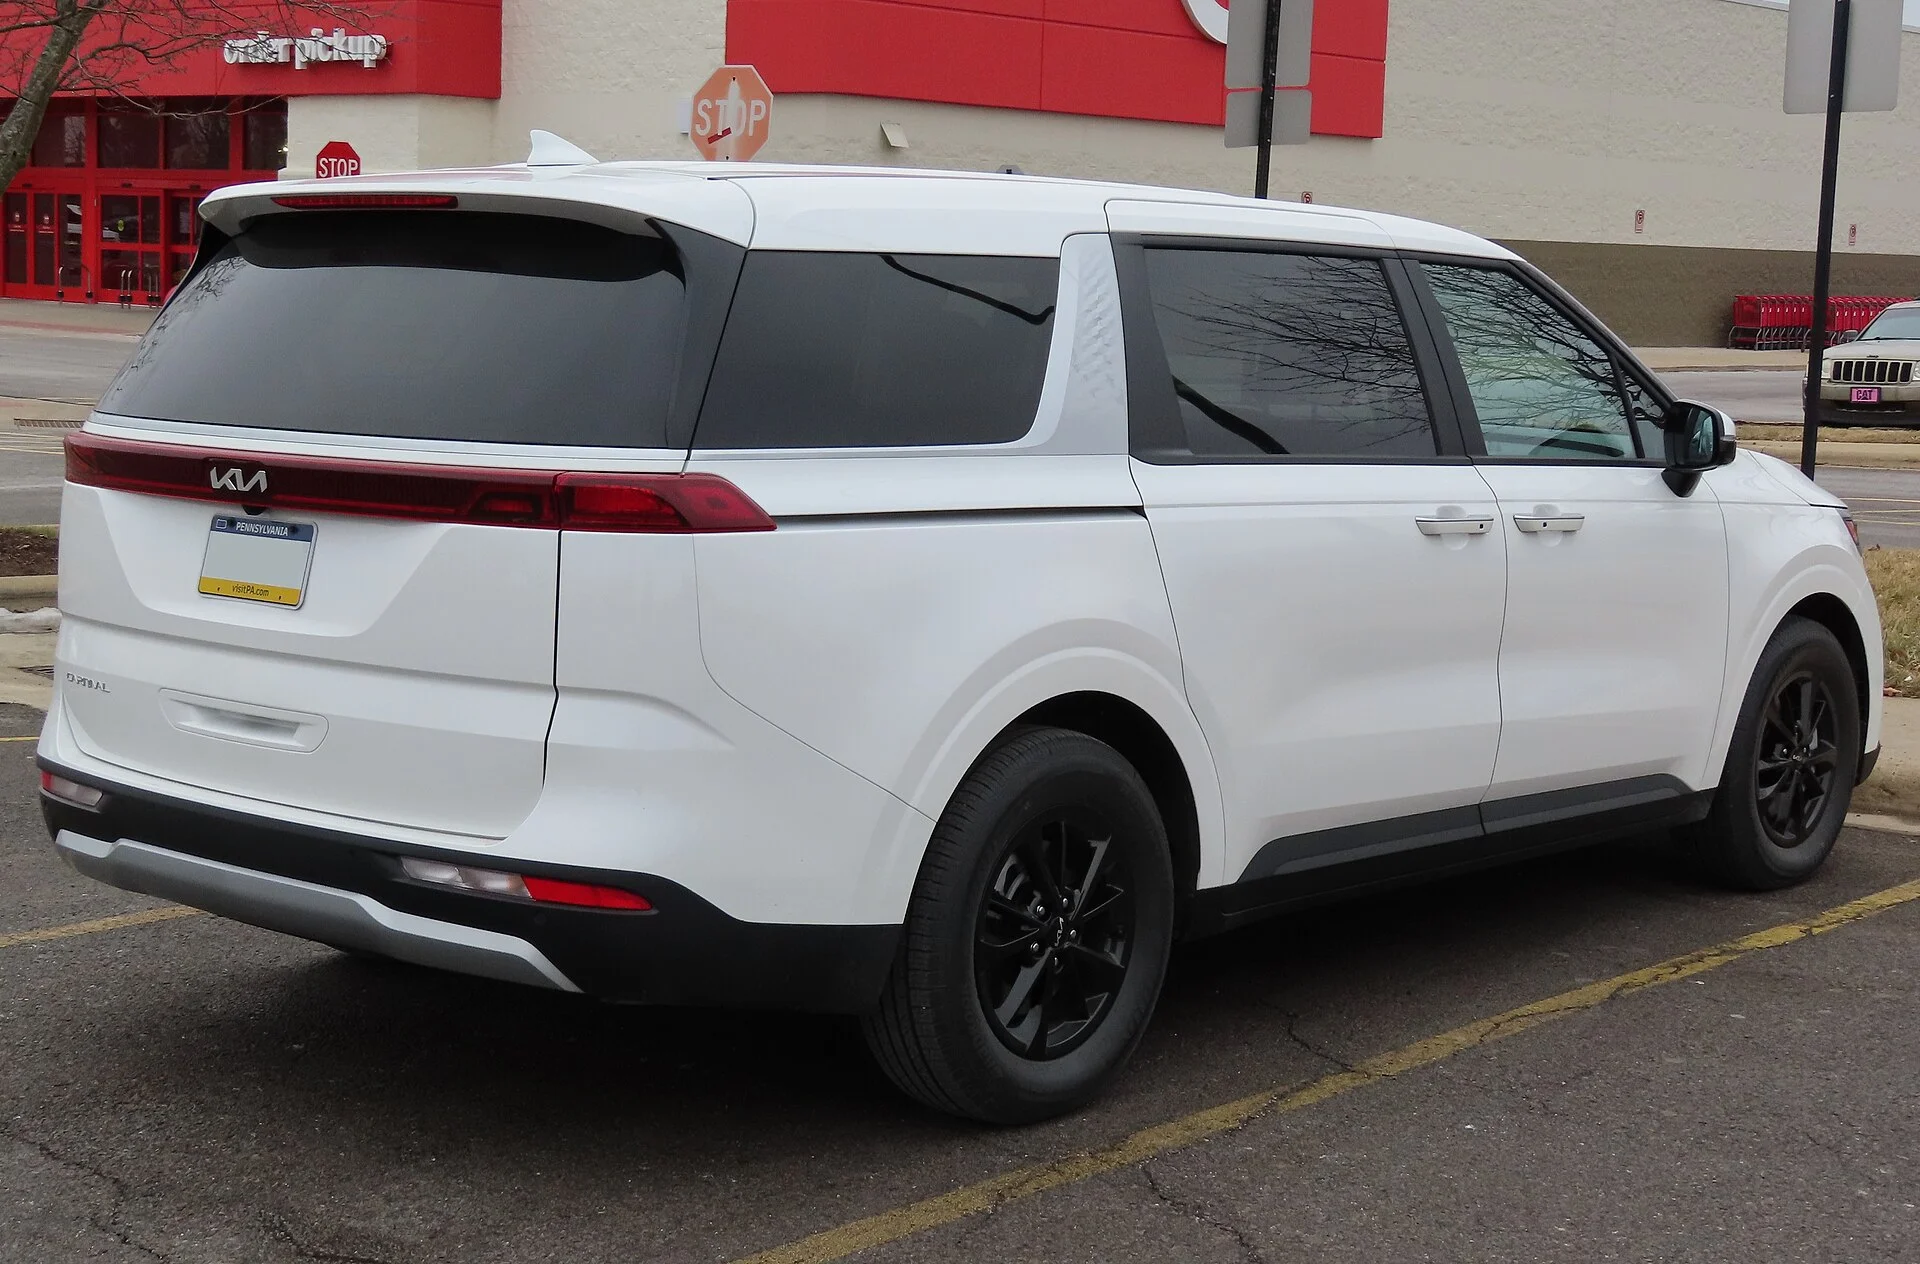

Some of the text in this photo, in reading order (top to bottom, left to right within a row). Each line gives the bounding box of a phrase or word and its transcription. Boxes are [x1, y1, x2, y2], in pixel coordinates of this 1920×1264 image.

[295, 28, 387, 69] pickup
[695, 99, 766, 136] STOP
[318, 157, 358, 178] STOP
[1856, 390, 1873, 400] CAT
[235, 522, 288, 536] PENNSYLVANIA
[232, 584, 269, 597] visitPA.com
